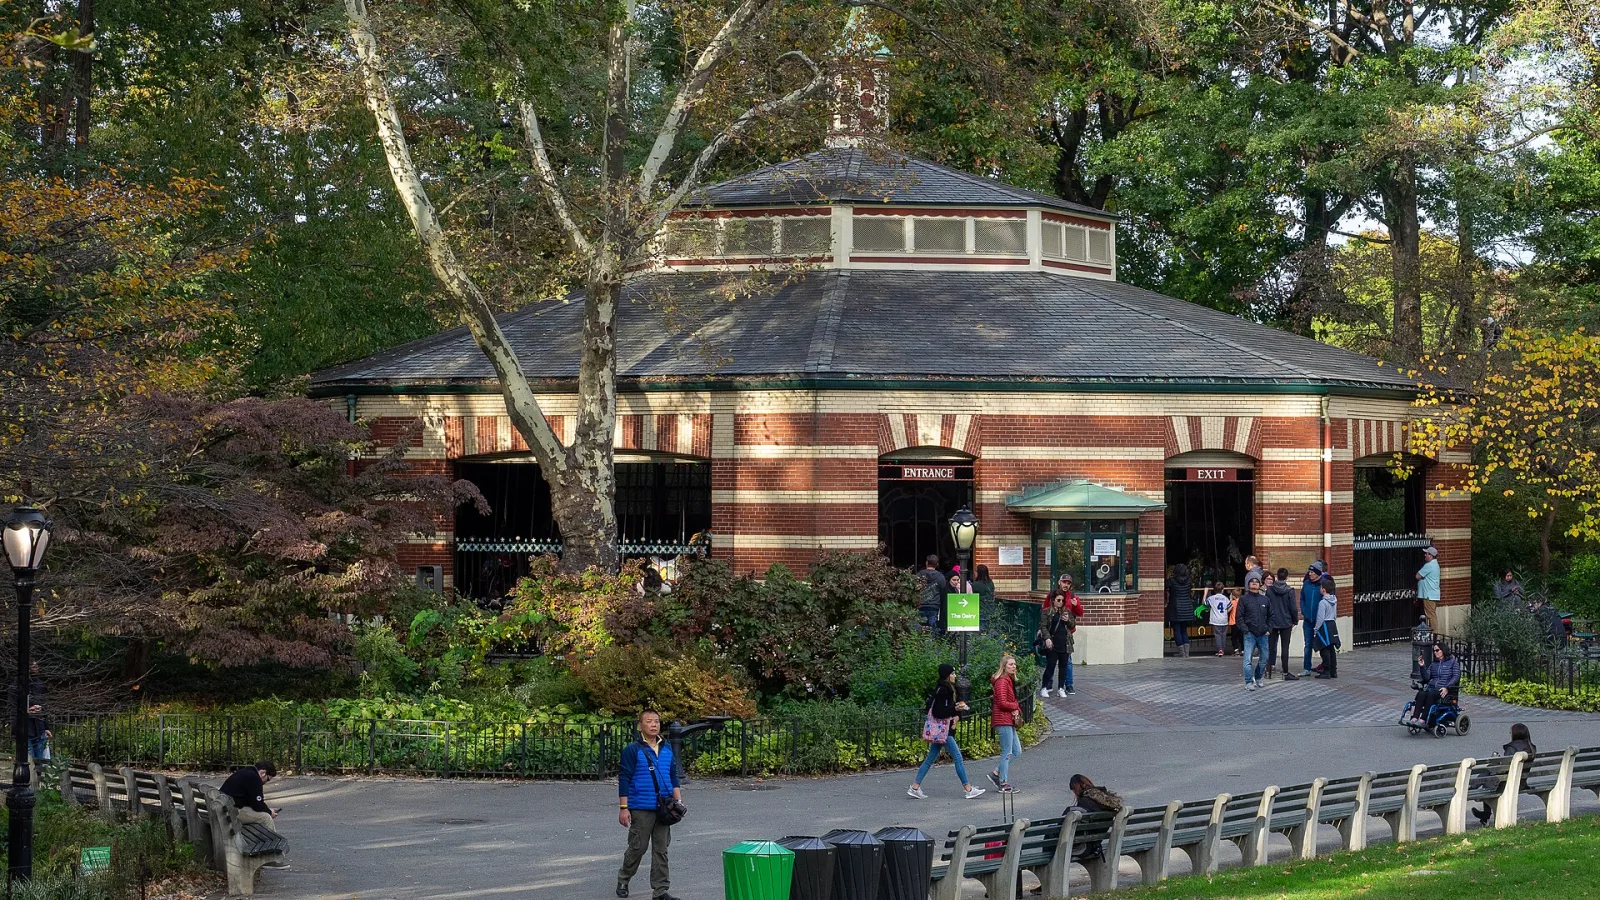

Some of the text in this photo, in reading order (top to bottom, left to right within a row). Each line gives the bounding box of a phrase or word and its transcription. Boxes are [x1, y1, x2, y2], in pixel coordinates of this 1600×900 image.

[903, 467, 953, 478] ENTRANCE
[1197, 469, 1226, 479] EXIT
[1216, 601, 1225, 614] 4
